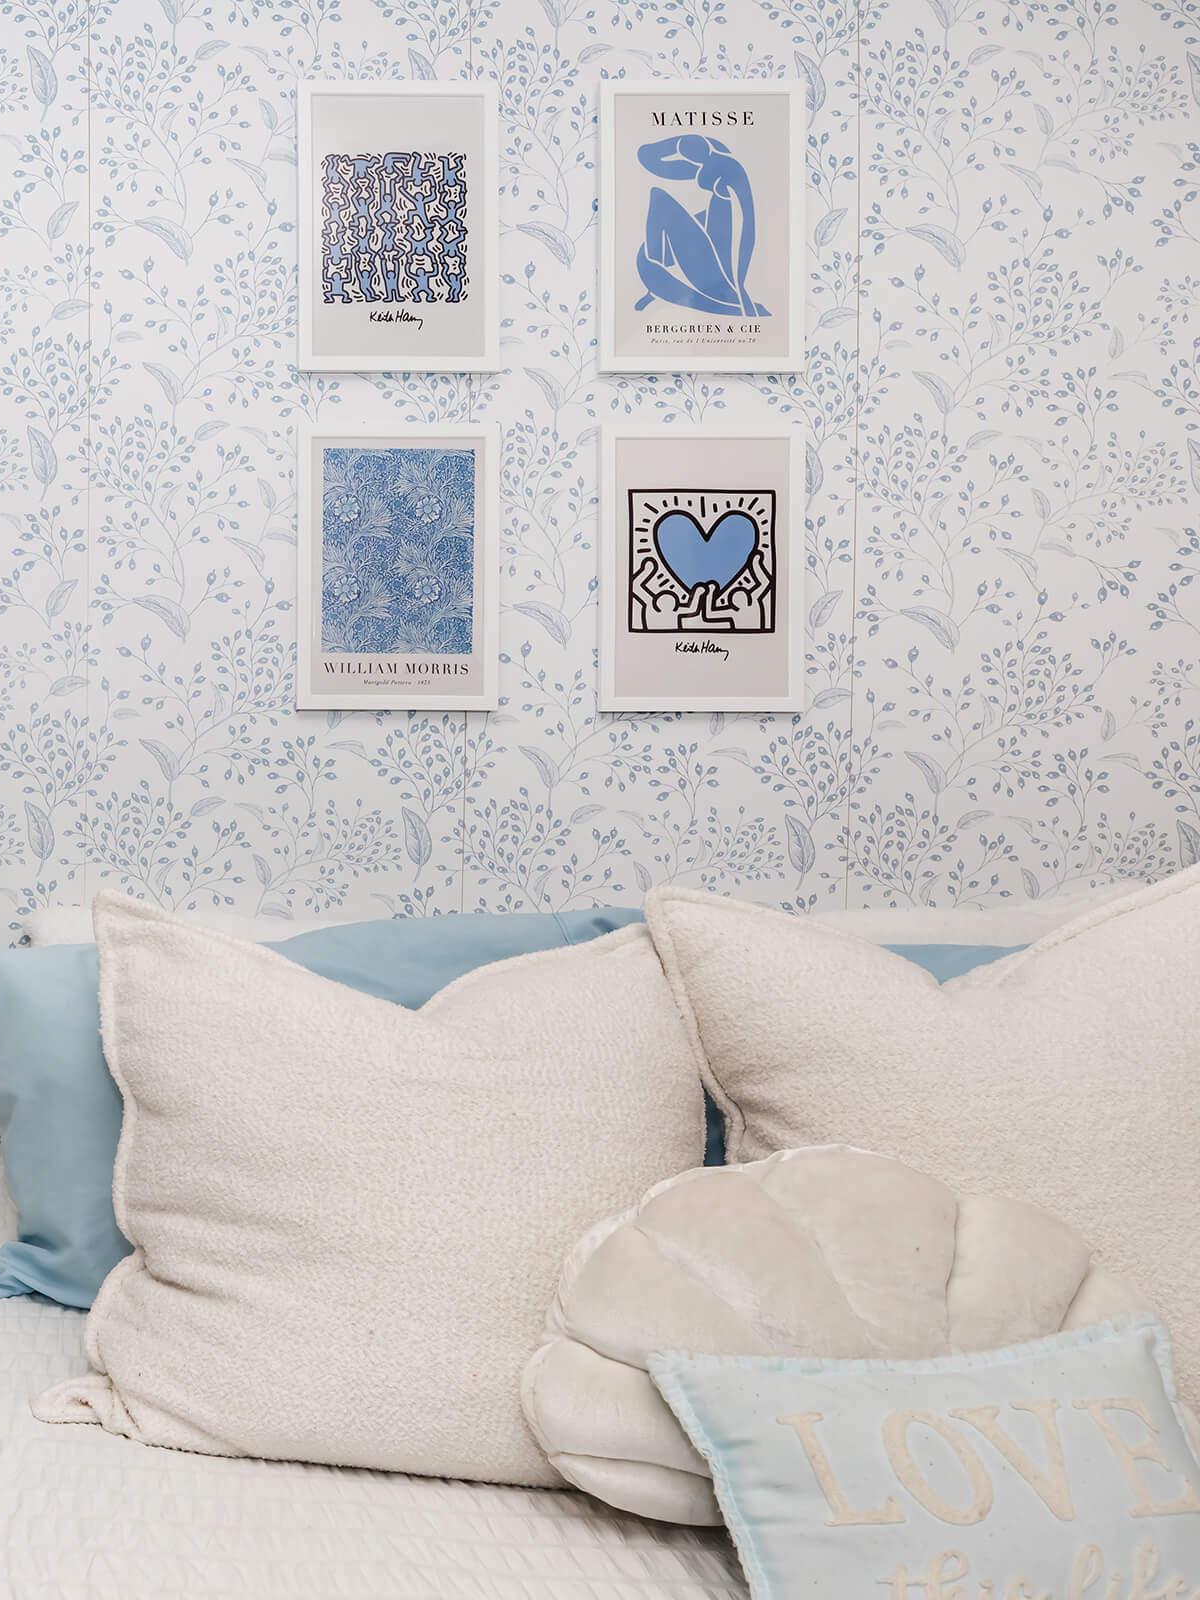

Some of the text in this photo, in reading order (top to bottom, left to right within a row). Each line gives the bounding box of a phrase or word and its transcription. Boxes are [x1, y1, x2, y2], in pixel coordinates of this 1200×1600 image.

[650, 111, 755, 126] MATISSE
[646, 324, 761, 334] BERGGRUEN & CIE
[323, 662, 470, 676] WILLIAM MORRIS
[775, 1396, 1200, 1527] LOVE
